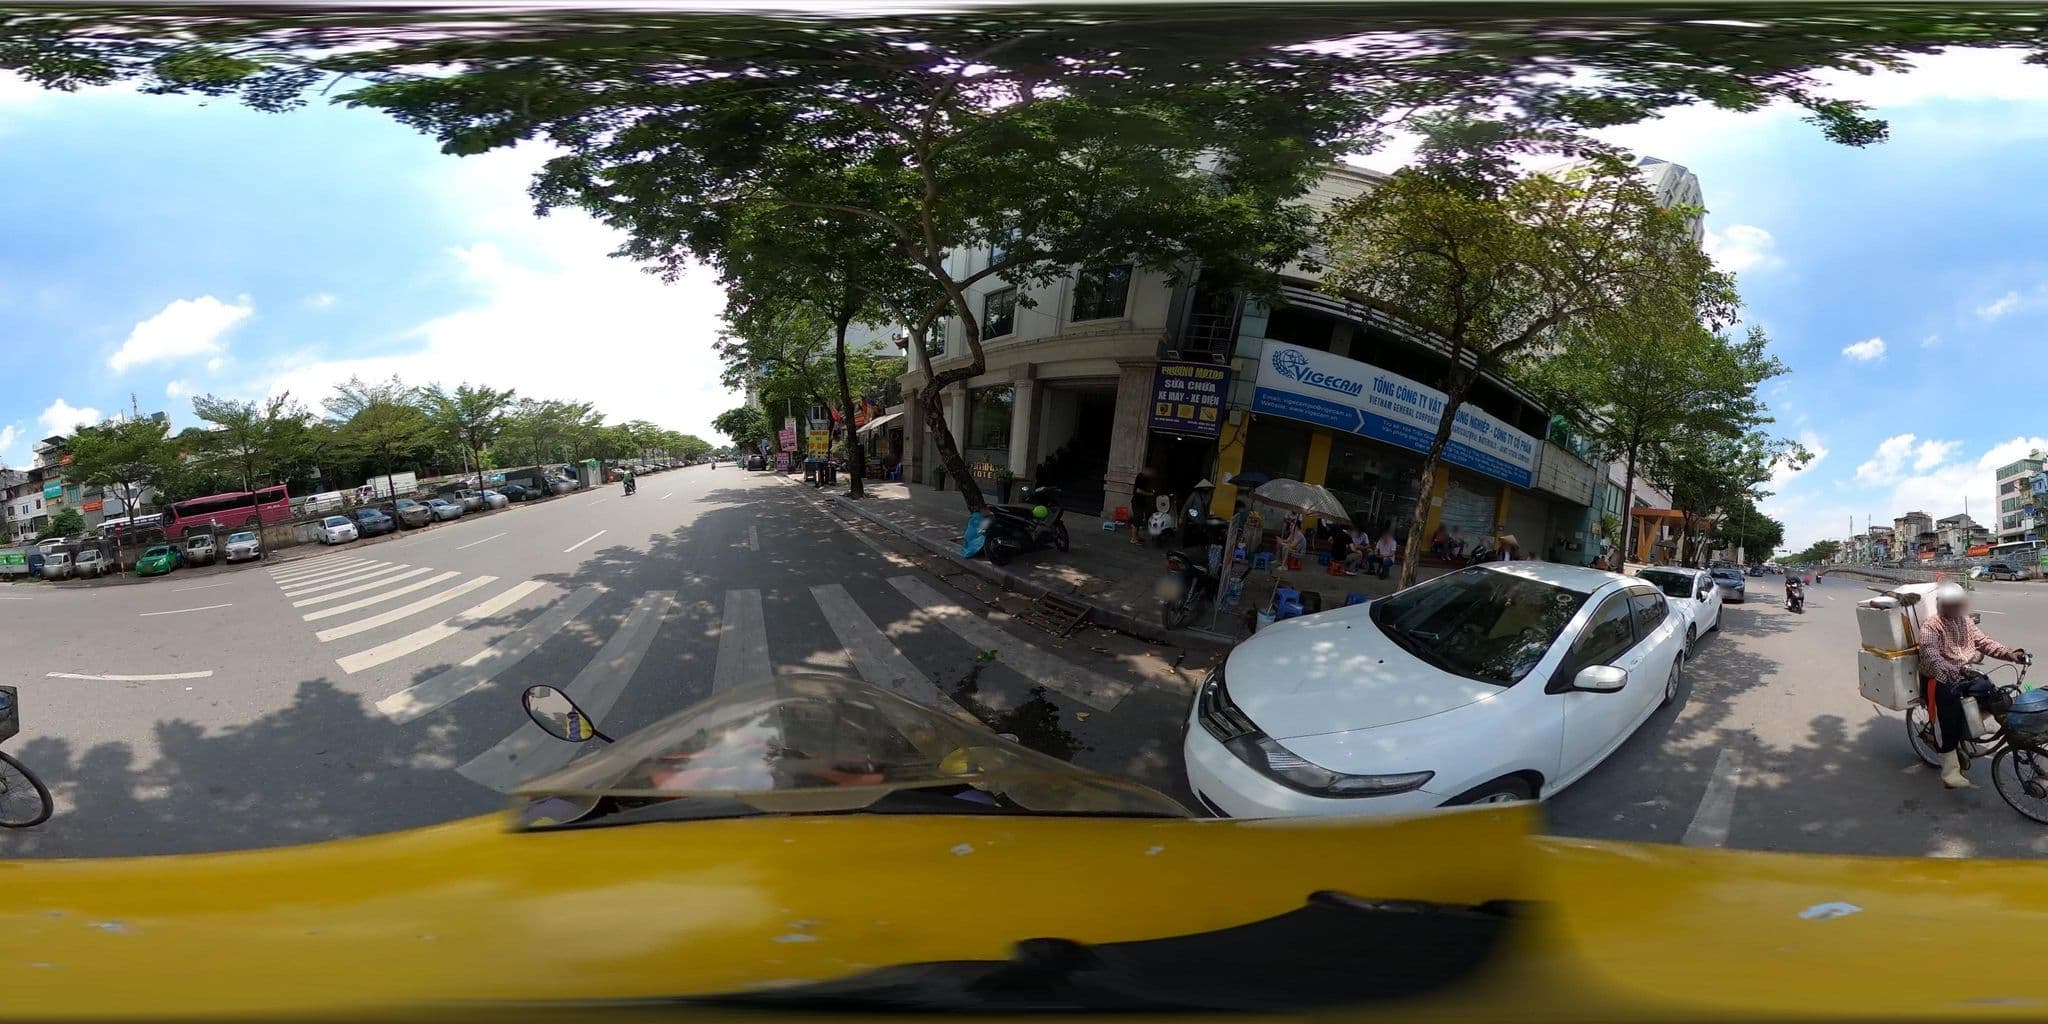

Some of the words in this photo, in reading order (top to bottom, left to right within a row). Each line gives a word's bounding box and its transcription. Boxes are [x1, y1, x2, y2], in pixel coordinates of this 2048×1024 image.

[1195, 367, 1224, 379] MOTOR
[1294, 366, 1363, 394] VIGECAM
[1164, 377, 1185, 389] SỬA
[1187, 380, 1216, 392] CHỮA
[1158, 390, 1167, 400] XE
[1168, 391, 1185, 402] MÁY
[1190, 393, 1200, 403] XE
[1201, 394, 1219, 406] ĐIỆN
[1373, 375, 1395, 397] TỔNG
[1396, 385, 1418, 405] CÔNG
[1419, 394, 1428, 409] TY
[1429, 396, 1442, 415] VẬT
[1369, 395, 1393, 410] VIETNAM
[1393, 403, 1414, 418] GENERAL
[1455, 410, 1470, 425] ÔNG
[973, 470, 997, 479] OTE
